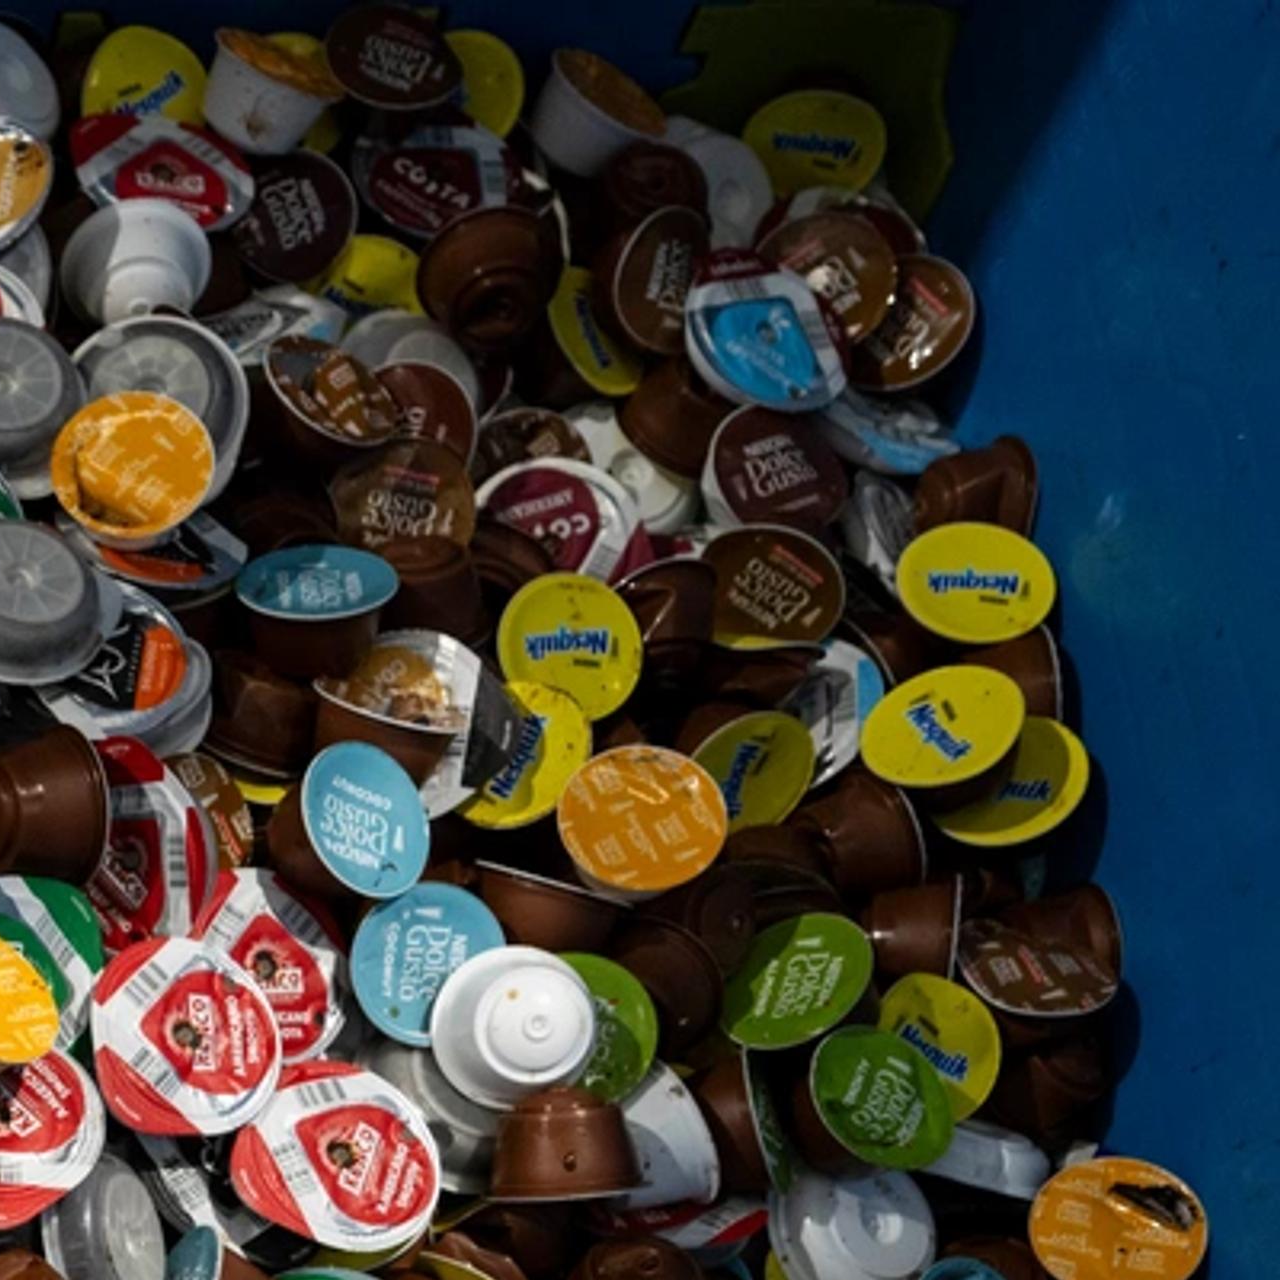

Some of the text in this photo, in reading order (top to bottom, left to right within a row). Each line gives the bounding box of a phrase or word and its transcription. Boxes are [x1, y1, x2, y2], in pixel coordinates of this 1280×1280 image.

[929, 569, 1017, 592] Nesquik
[524, 628, 609, 659] Nesquik
[907, 704, 971, 760] Nesquik
[382, 923, 397, 996] COCONUT
[400, 925, 420, 1004] Gusto
[227, 995, 244, 1075] AMERICANO
[246, 1008, 257, 1063] SMOOTH
